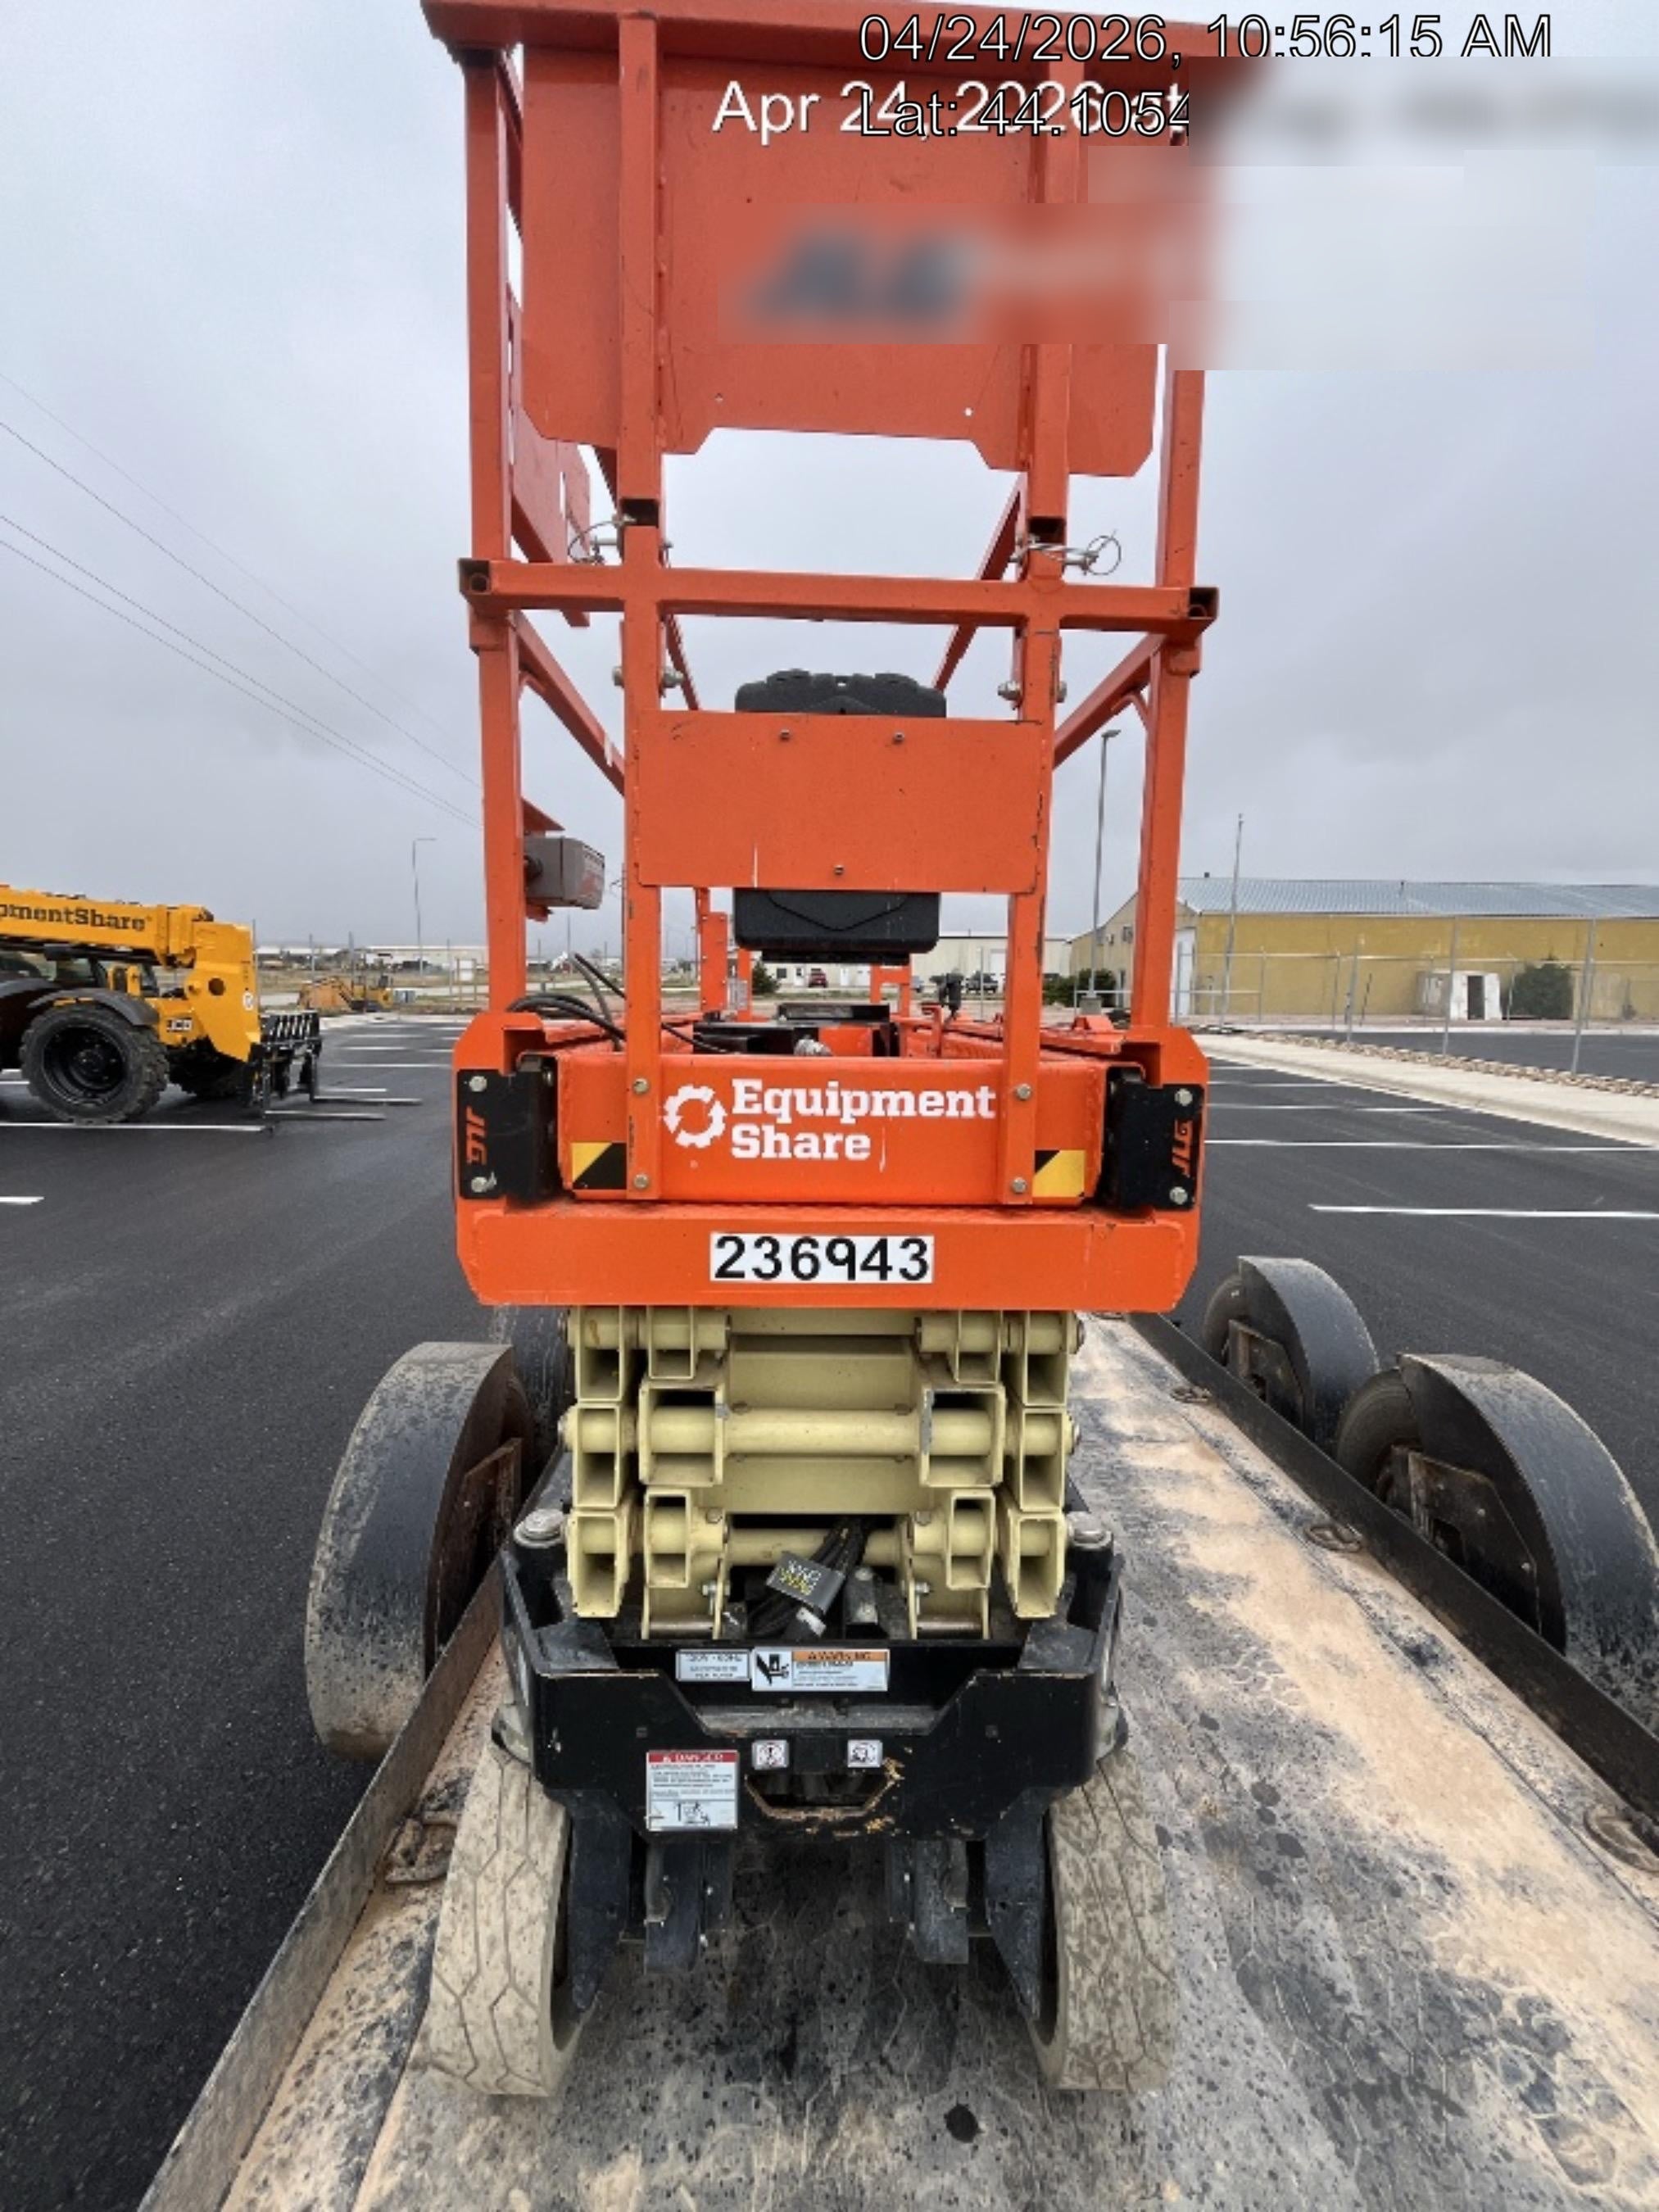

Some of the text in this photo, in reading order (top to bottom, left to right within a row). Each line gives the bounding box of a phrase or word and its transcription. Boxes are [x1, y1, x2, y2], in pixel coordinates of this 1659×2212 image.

[732, 1078, 996, 1124] Equipment
[466, 1106, 487, 1165] JLG
[732, 1123, 871, 1160] Share
[1172, 1119, 1193, 1177] JLG
[714, 1235, 929, 1281] 236943
